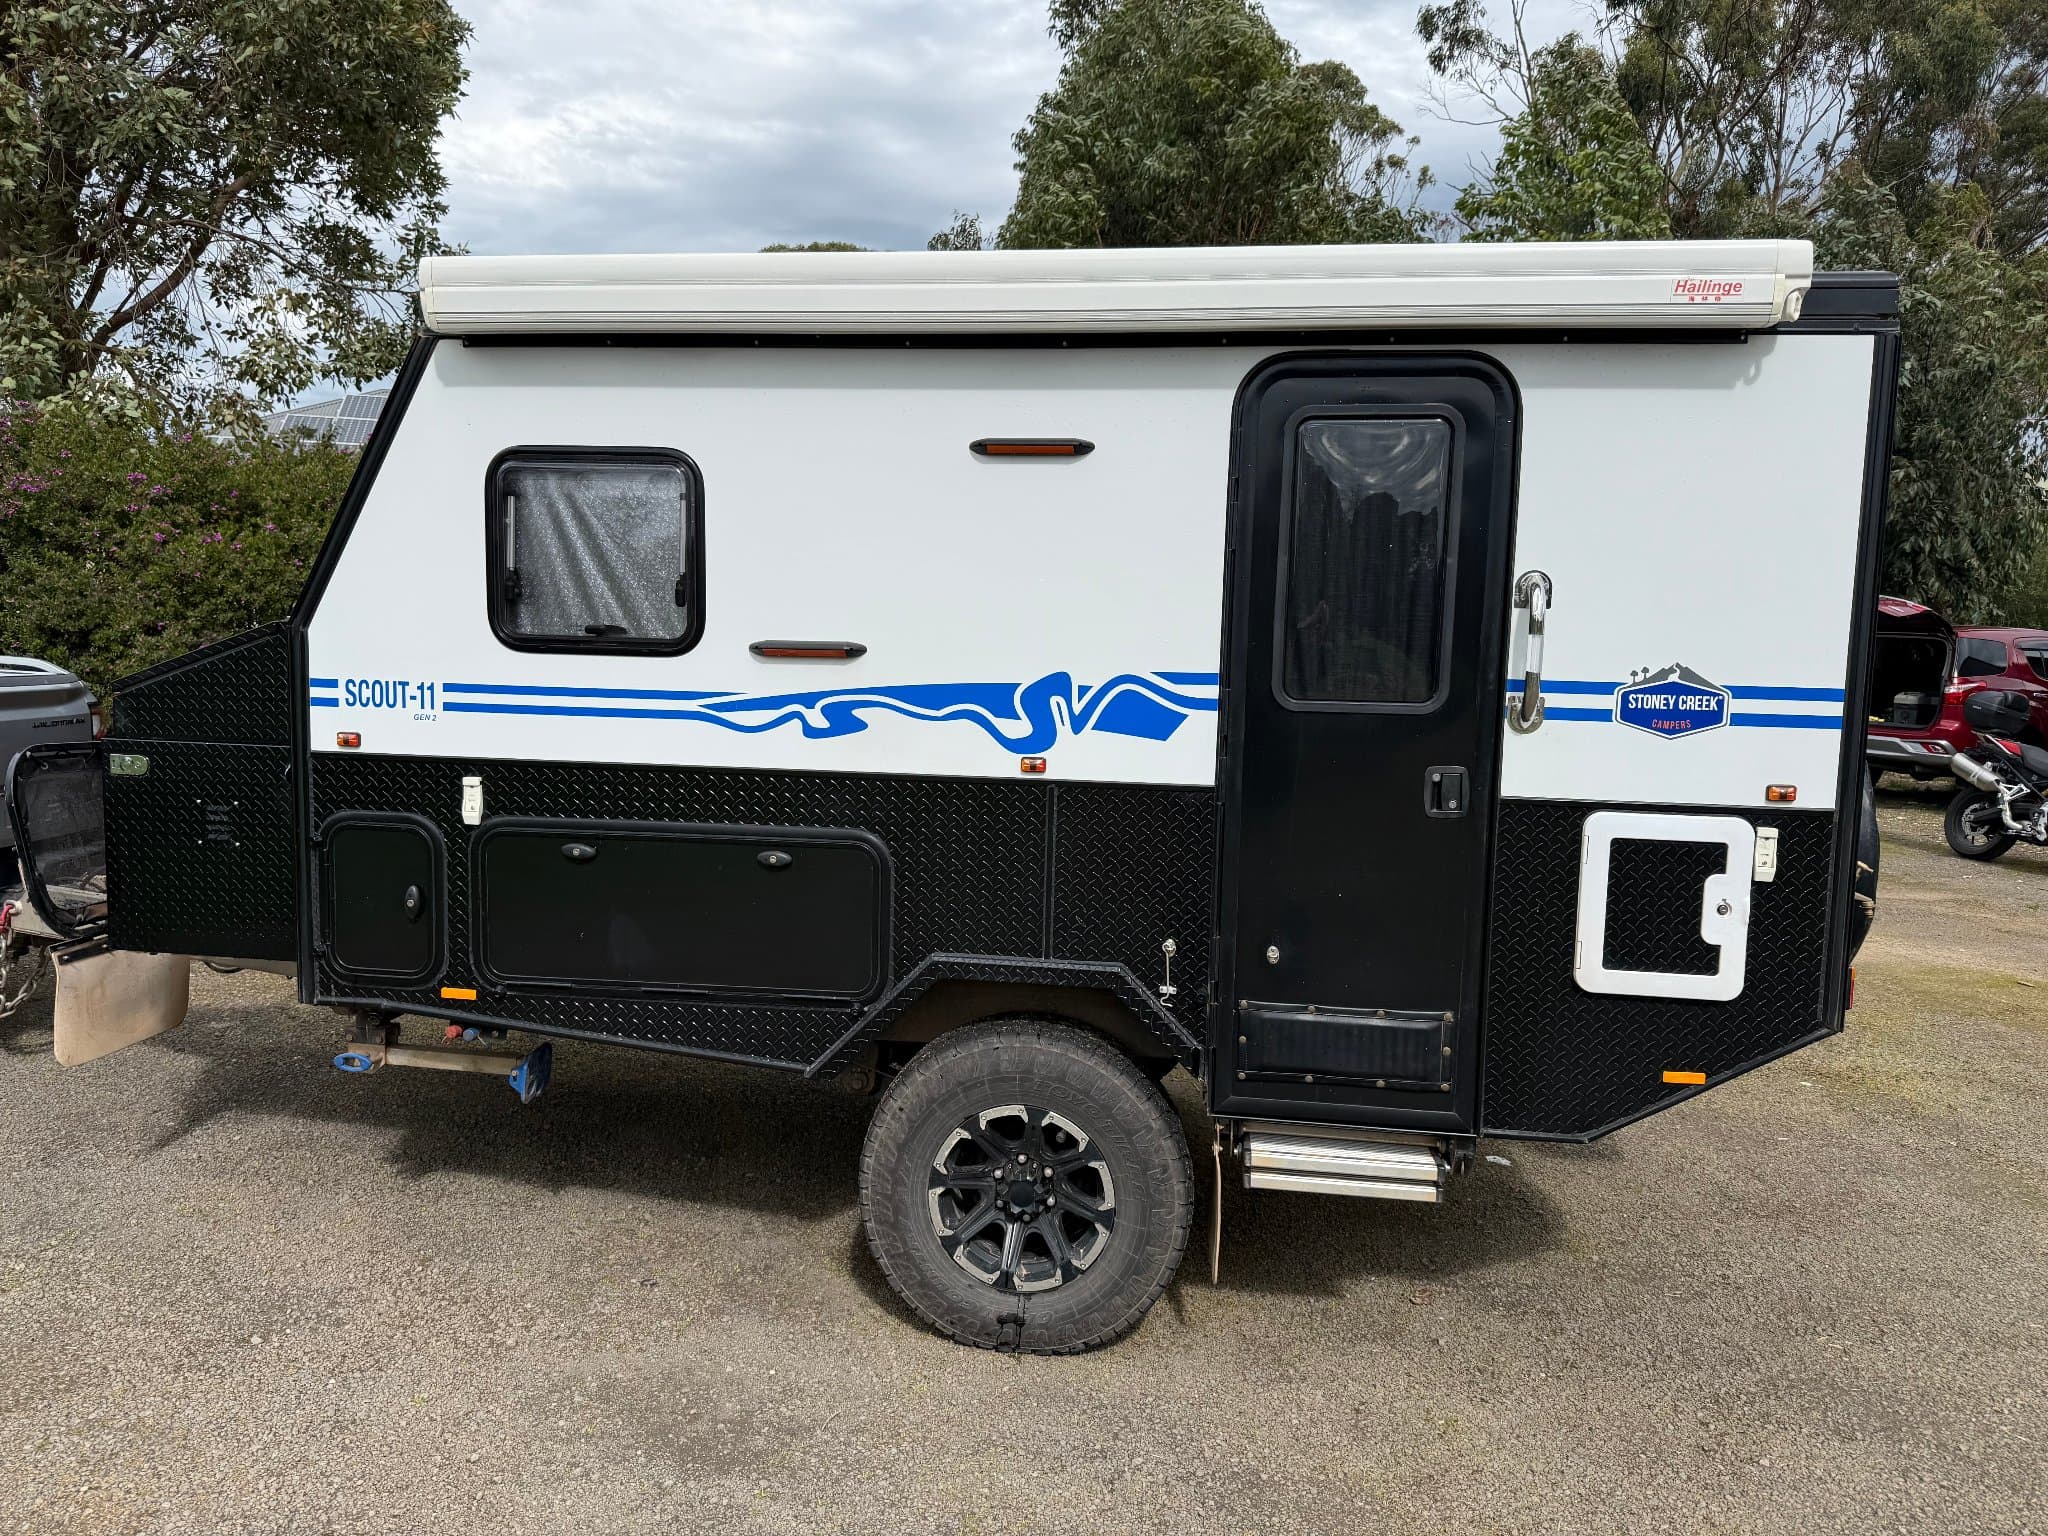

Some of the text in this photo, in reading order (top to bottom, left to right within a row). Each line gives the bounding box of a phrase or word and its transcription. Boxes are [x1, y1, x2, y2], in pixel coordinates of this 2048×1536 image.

[1674, 279, 1743, 296] Hailinge
[345, 678, 435, 710] SCOUT-11
[1628, 693, 1718, 711] STONEY CREEK
[413, 713, 431, 721] GEN
[1651, 719, 1692, 730] CAMPERS
